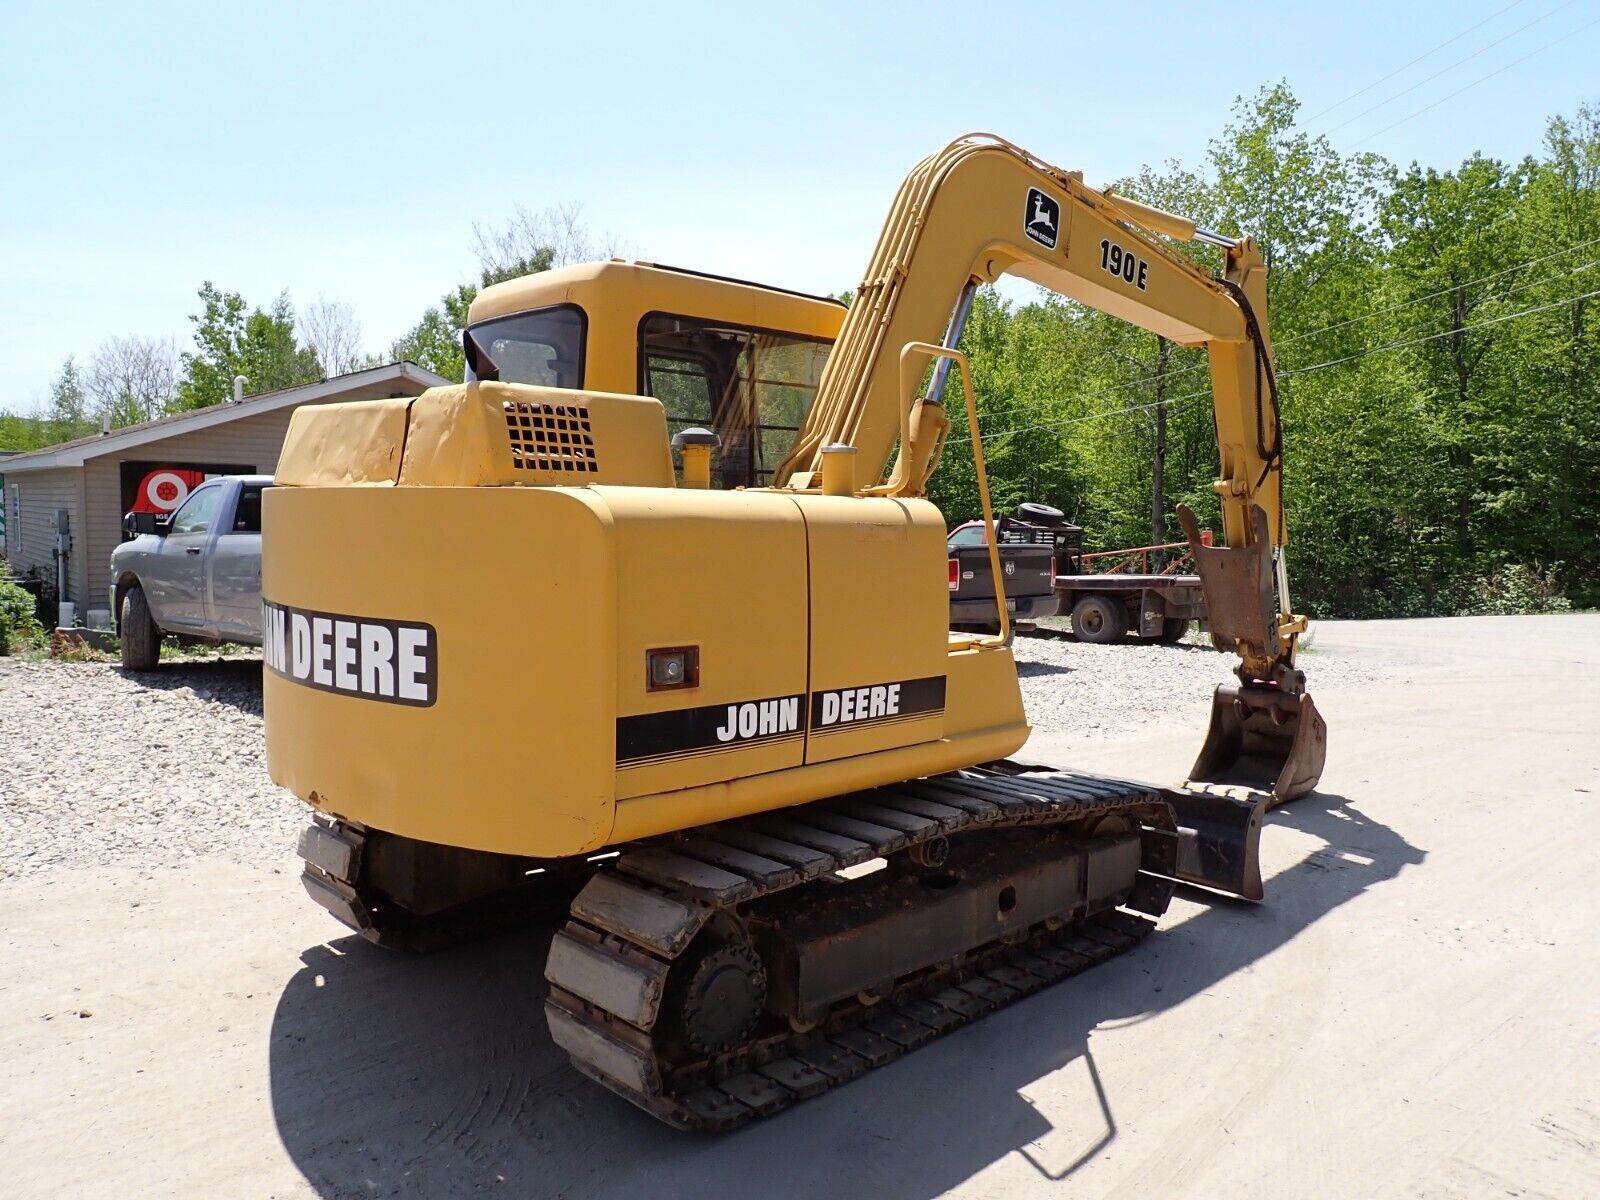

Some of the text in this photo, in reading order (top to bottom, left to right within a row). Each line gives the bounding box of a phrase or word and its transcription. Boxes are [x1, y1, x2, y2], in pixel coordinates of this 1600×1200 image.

[261, 600, 429, 702] HN DEERE
[716, 683, 901, 743] JOHN DEERE
